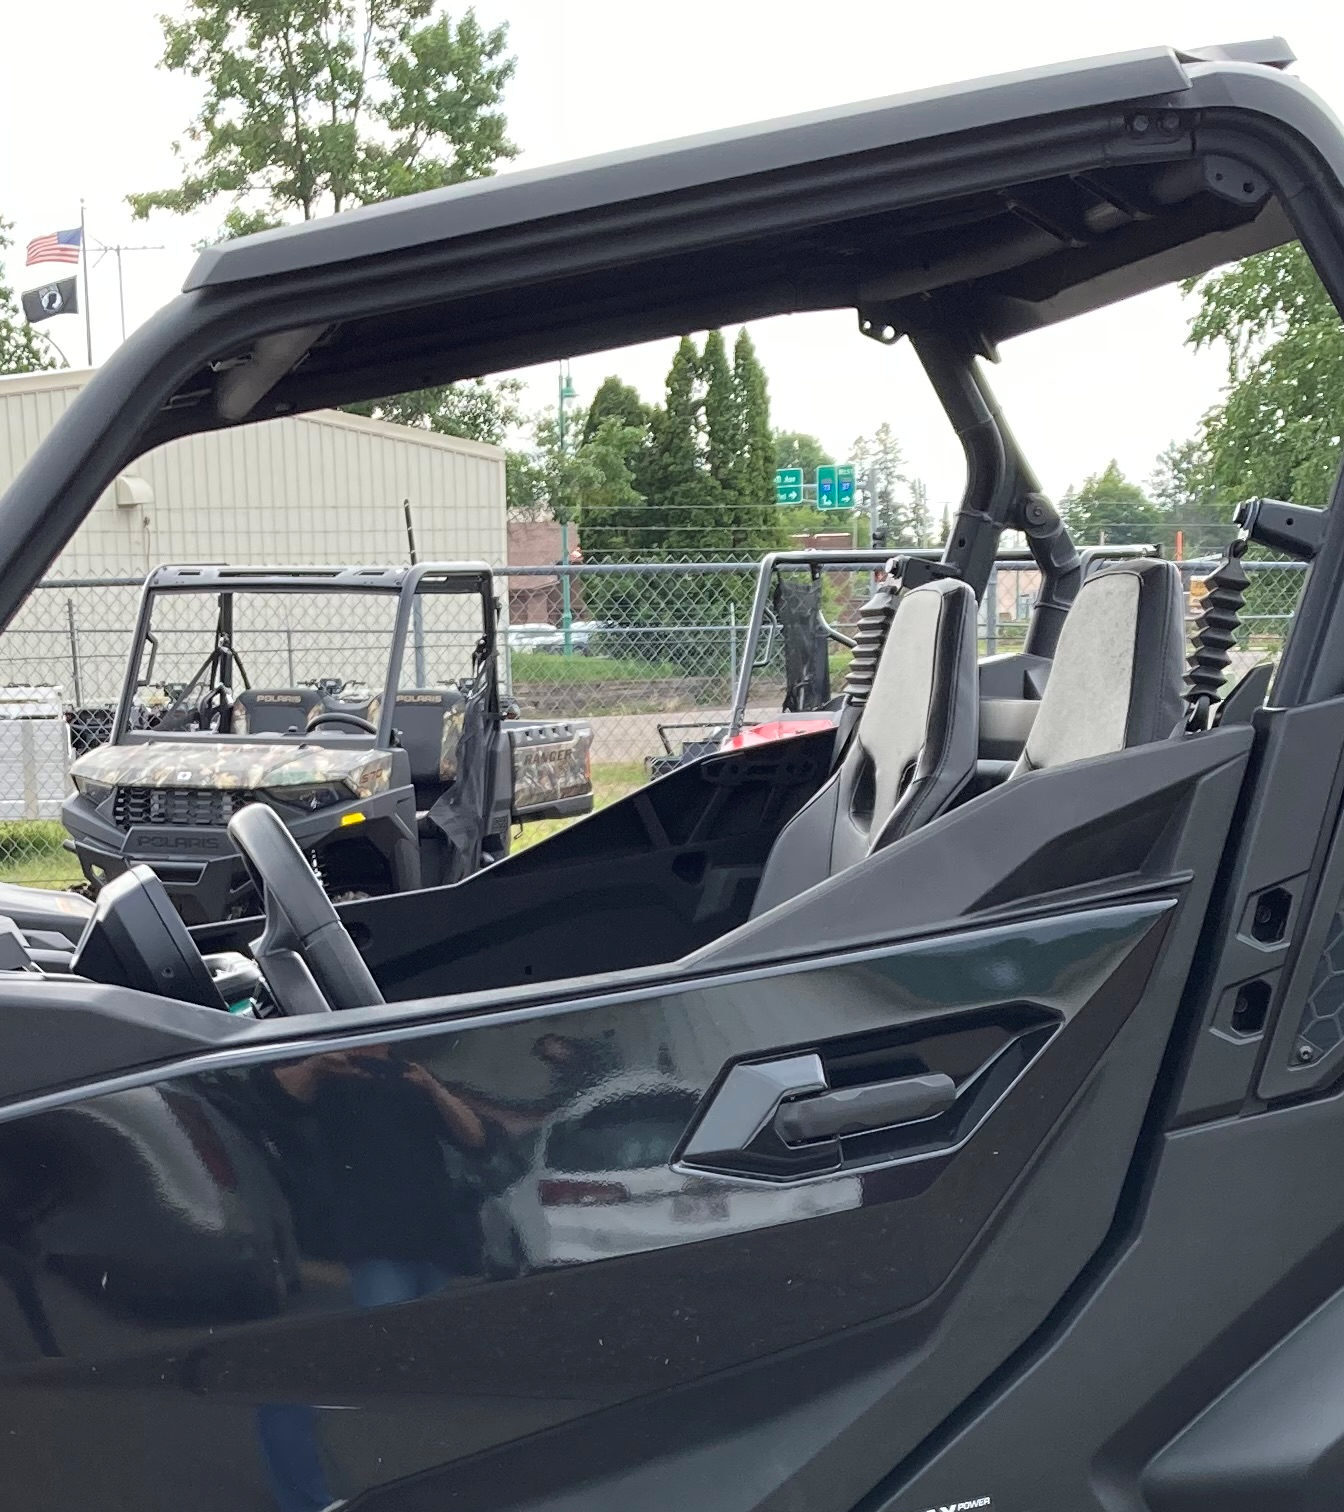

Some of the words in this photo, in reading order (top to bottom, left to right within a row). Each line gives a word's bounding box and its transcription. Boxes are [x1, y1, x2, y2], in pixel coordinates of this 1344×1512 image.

[256, 694, 302, 703] POLARIS
[396, 694, 442, 703] POLARIS
[524, 749, 574, 766] RANGER
[137, 834, 219, 849] POLARIS
[957, 1496, 991, 1511] POWER
